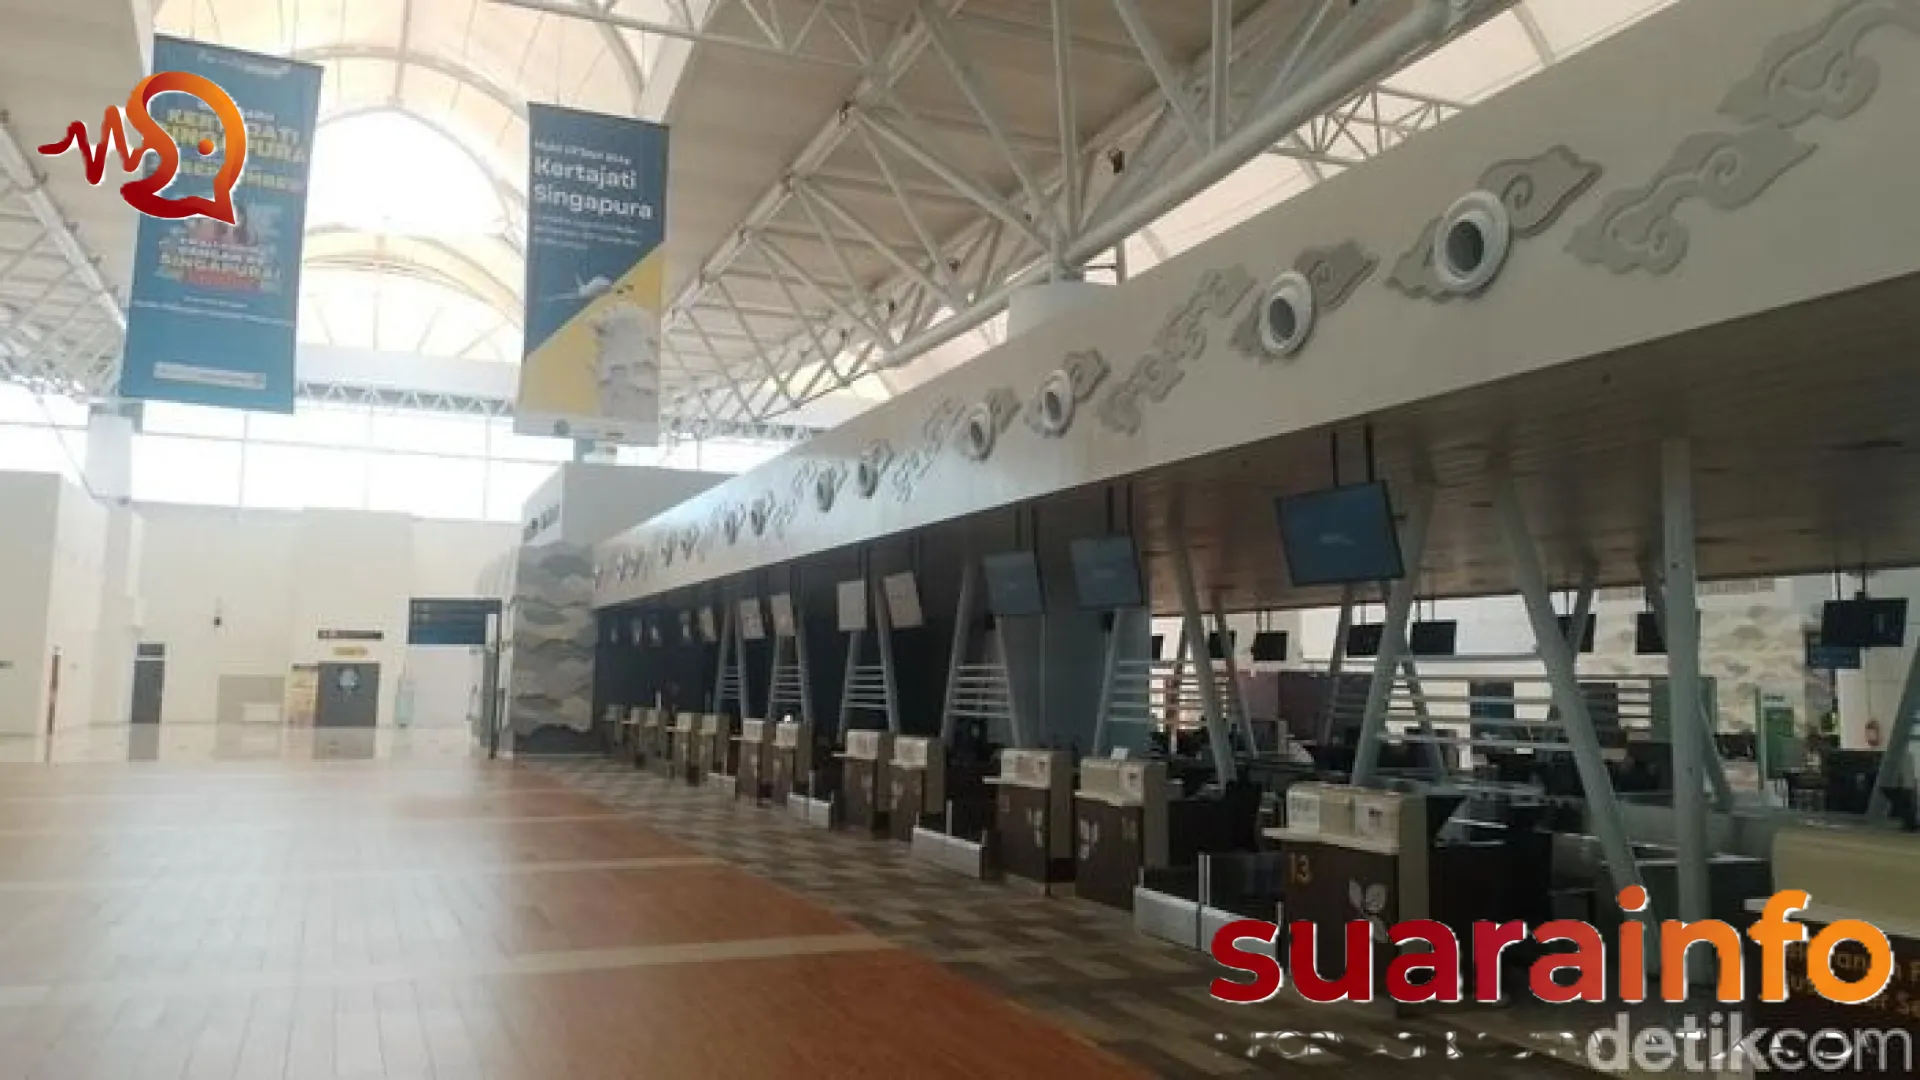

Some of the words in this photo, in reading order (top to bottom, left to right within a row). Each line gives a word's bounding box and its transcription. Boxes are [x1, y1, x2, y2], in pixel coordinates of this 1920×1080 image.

[534, 155, 637, 190] Kertajati
[534, 183, 654, 220] Singapura
[1290, 853, 1313, 885] 13
